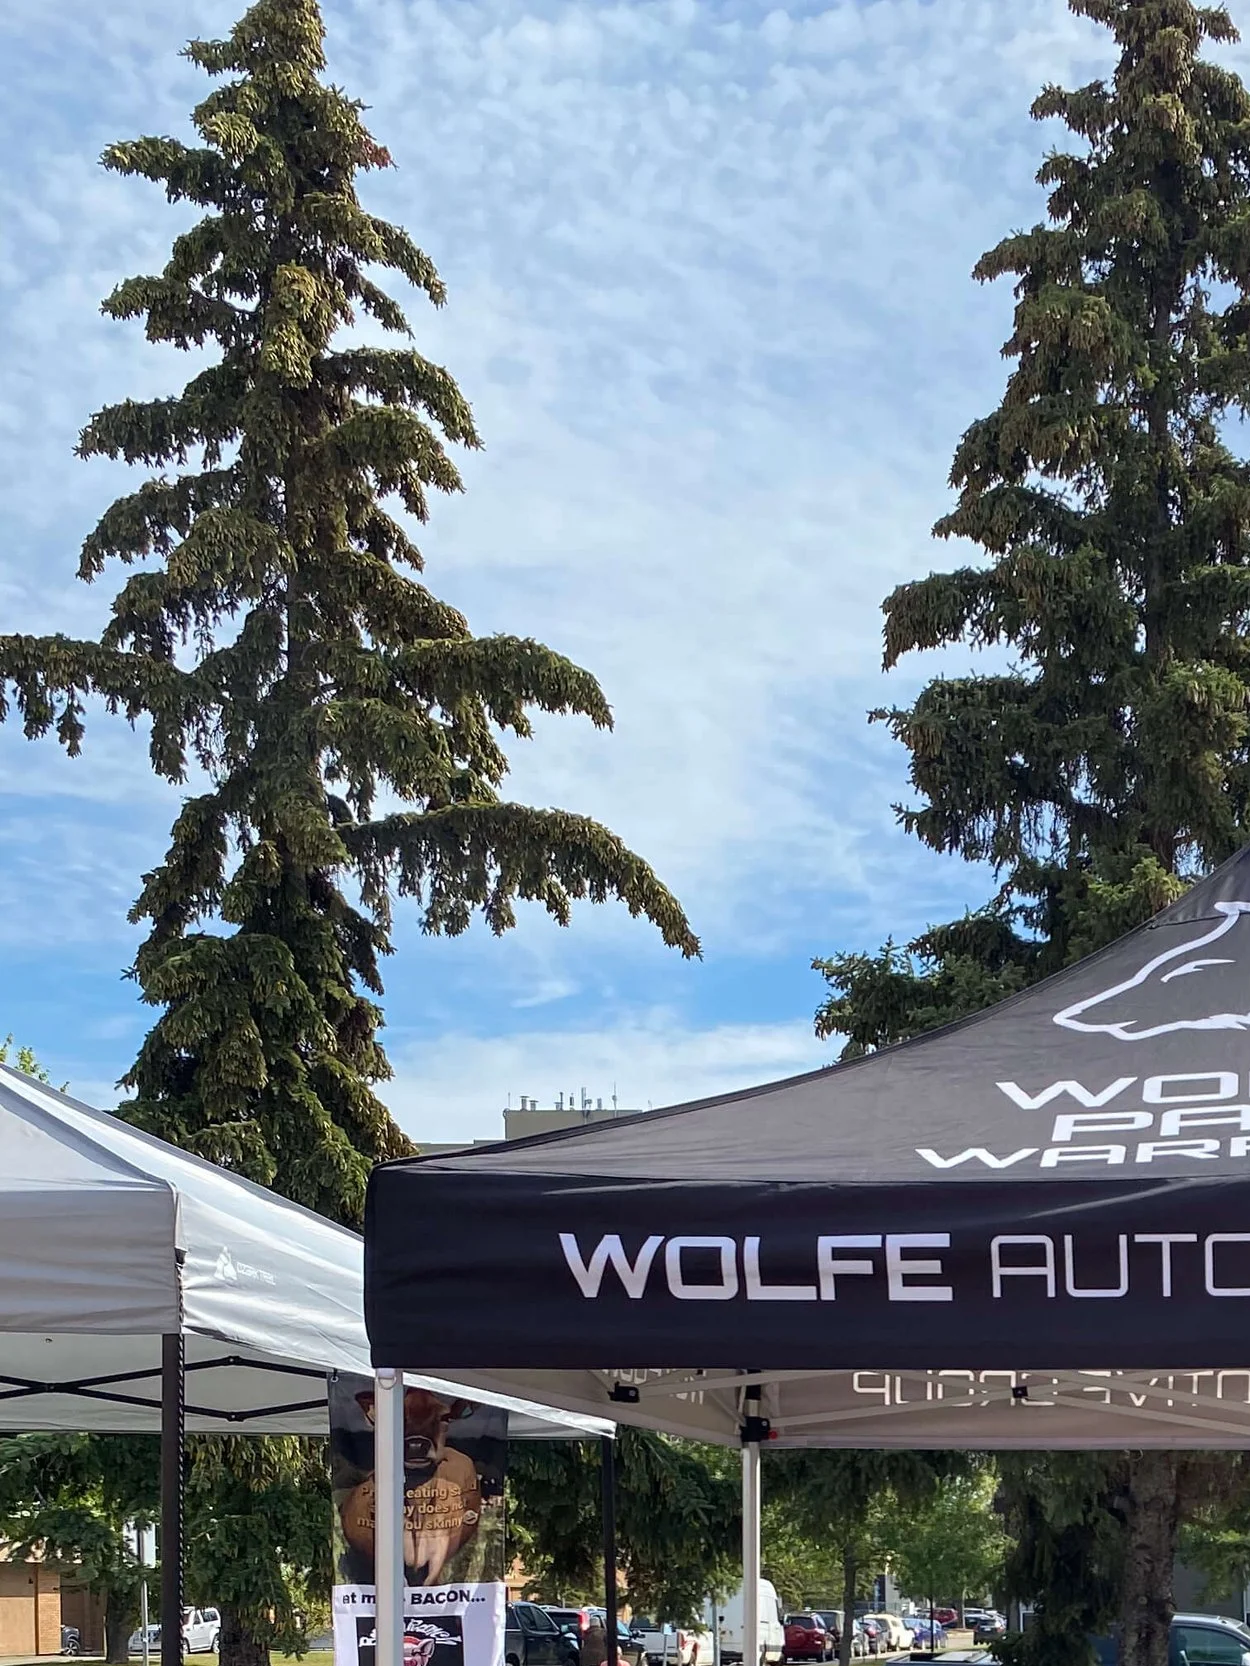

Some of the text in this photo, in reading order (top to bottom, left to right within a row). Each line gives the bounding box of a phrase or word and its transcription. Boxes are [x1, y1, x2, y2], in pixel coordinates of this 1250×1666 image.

[559, 1232, 953, 1301] WOLFE
[406, 1486, 447, 1500] eating
[418, 1503, 449, 1513] does
[425, 1516, 463, 1529] skinny
